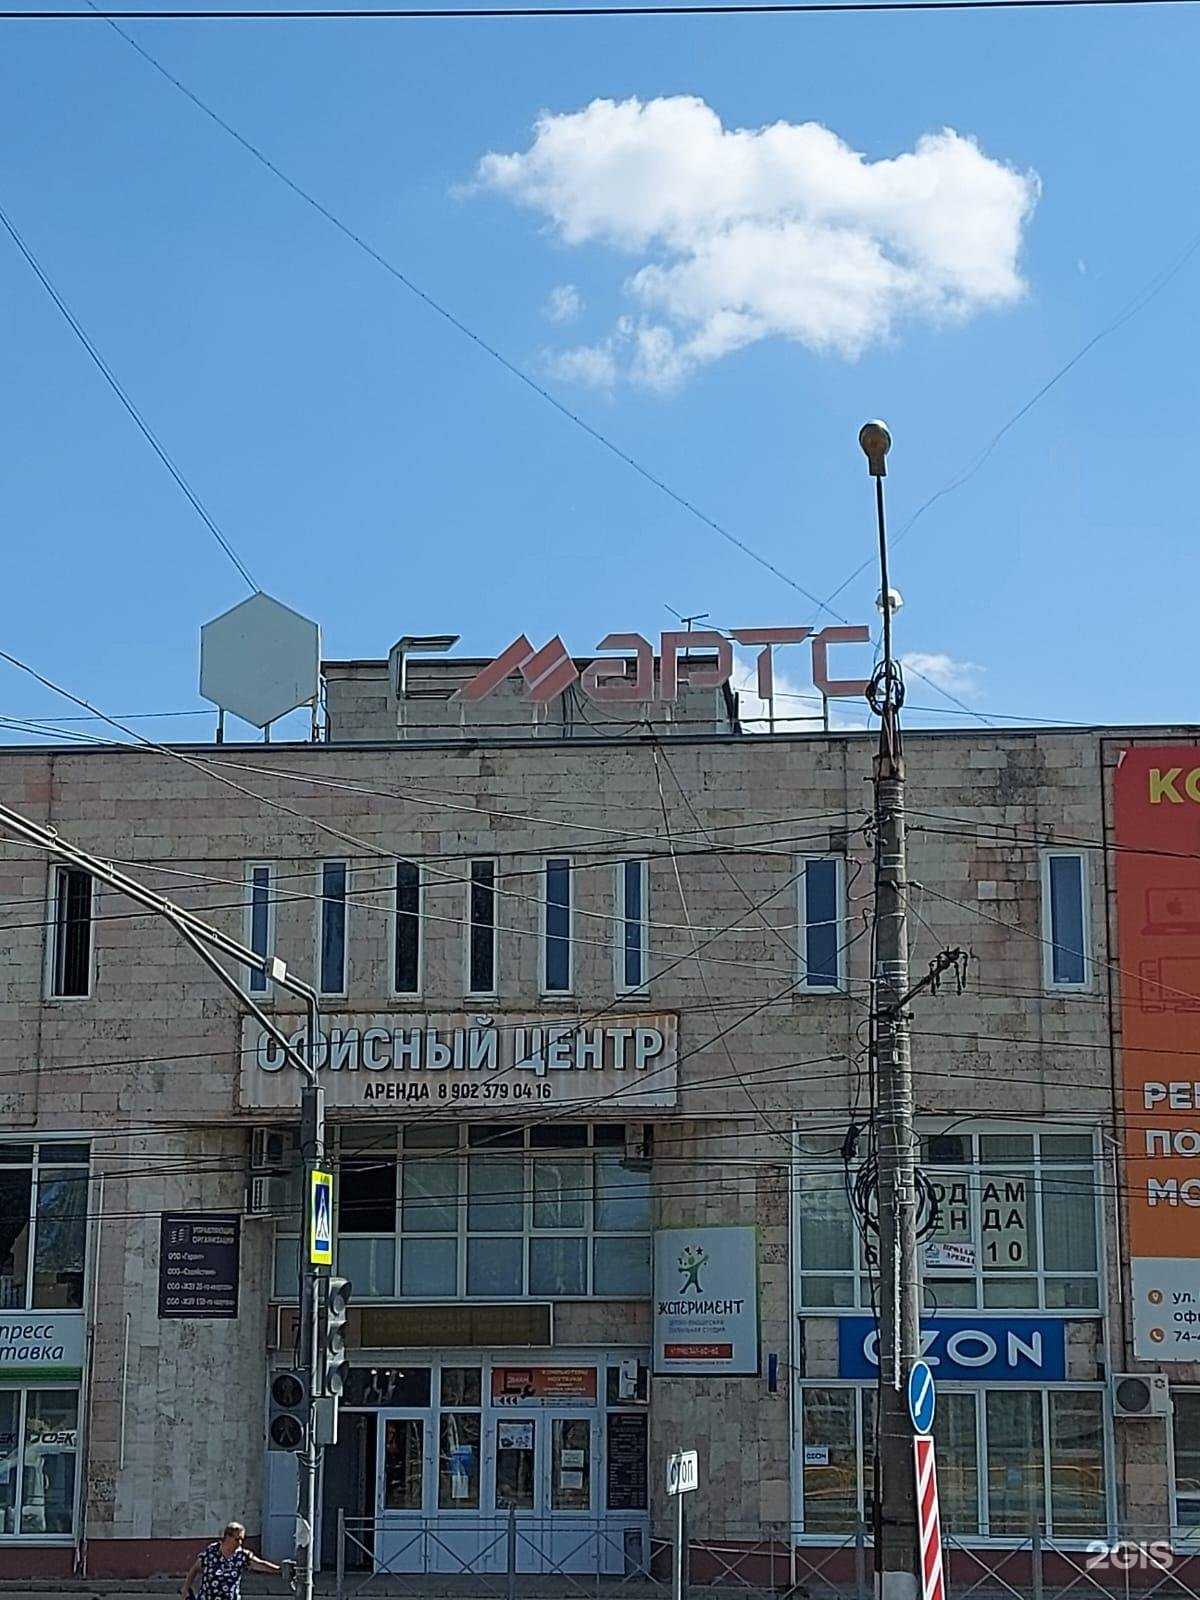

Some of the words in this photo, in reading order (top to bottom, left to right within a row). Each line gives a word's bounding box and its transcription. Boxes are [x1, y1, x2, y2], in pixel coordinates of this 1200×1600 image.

[256, 1014, 499, 1073] ОФИСНЫЙ
[513, 1026, 665, 1077] ЦЕНТР
[364, 1082, 430, 1100] АРЕНДА
[438, 1083, 448, 1099] 8
[451, 1083, 479, 1100] 902
[482, 1083, 509, 1100] 379
[512, 1083, 533, 1099] 04
[535, 1083, 552, 1099] 16
[1144, 1081, 1200, 1110] РЕ
[987, 1240, 1022, 1262] 10
[1172, 1292, 1196, 1305] ул.
[1173, 1309, 1200, 1325] оф
[1172, 1330, 1200, 1343] 74-
